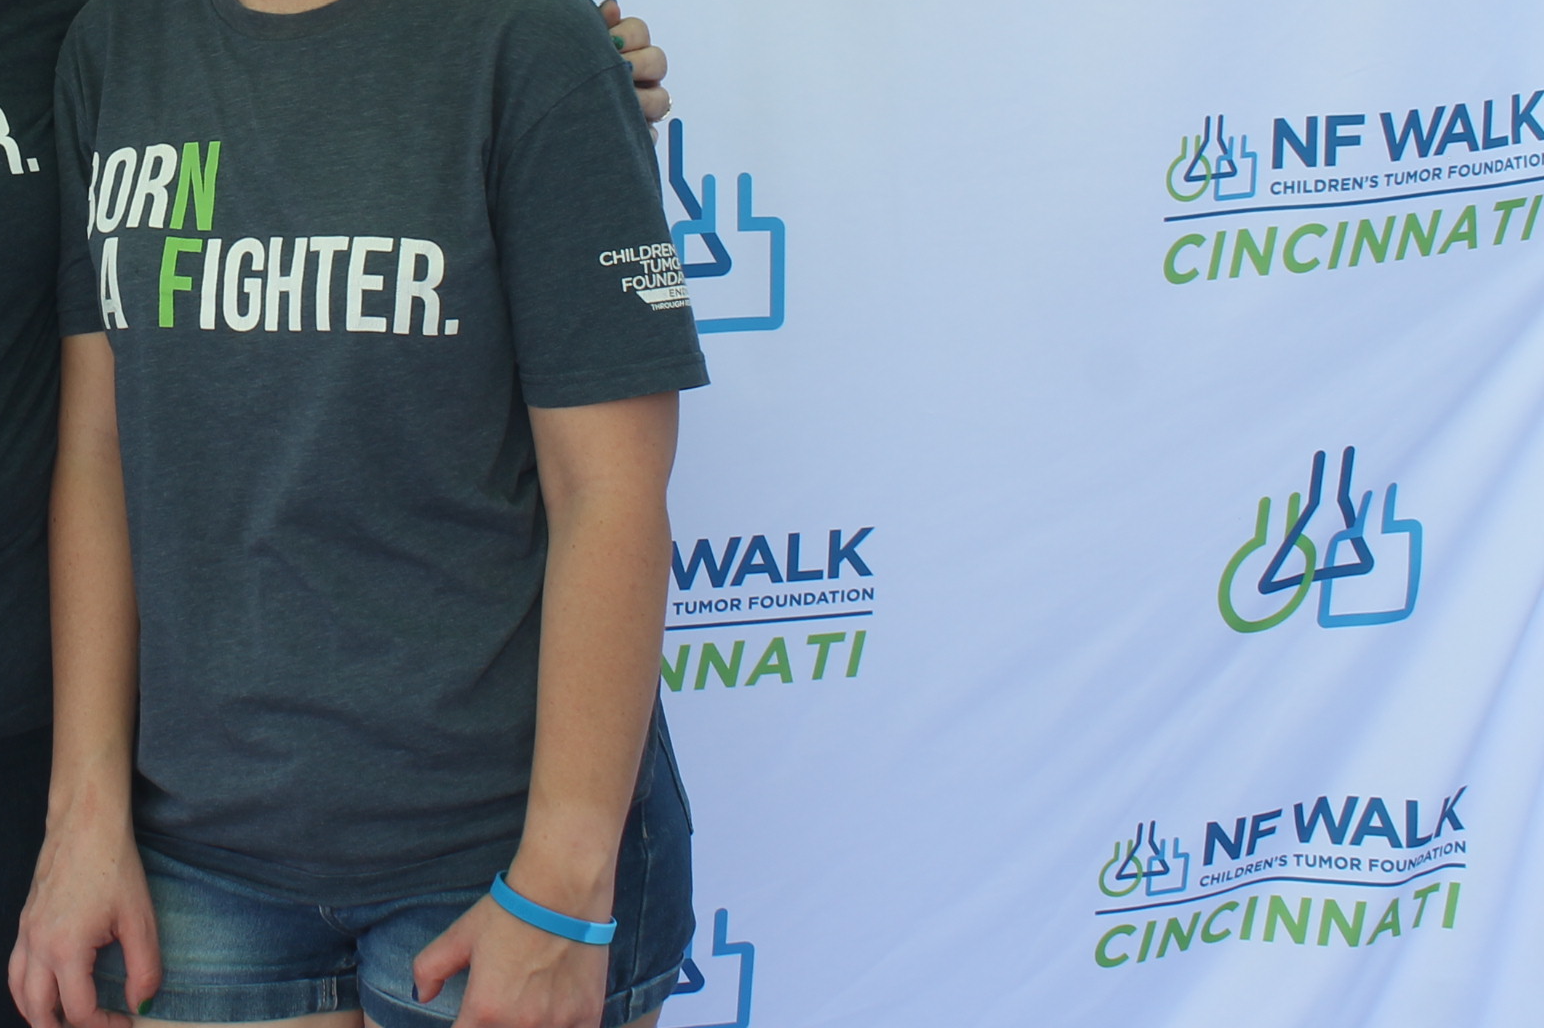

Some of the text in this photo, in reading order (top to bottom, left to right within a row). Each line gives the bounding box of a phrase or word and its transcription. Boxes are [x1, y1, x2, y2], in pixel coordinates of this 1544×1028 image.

[1272, 90, 1544, 170] NF WALK
[1270, 152, 1544, 196] CHILDREN'S TUMOR FOUNDATIO
[1163, 194, 1543, 285] CINCINNATI
[100, 236, 459, 336] A FIGHTER.
[671, 526, 875, 591] WALK
[673, 587, 874, 616] TUMOR FOUNDATION
[1199, 840, 1466, 887] CHILDREN'S TUMOR FOUNDATION
[1203, 785, 1468, 866] NF WALK
[1094, 882, 1461, 968] CINCINNATI
